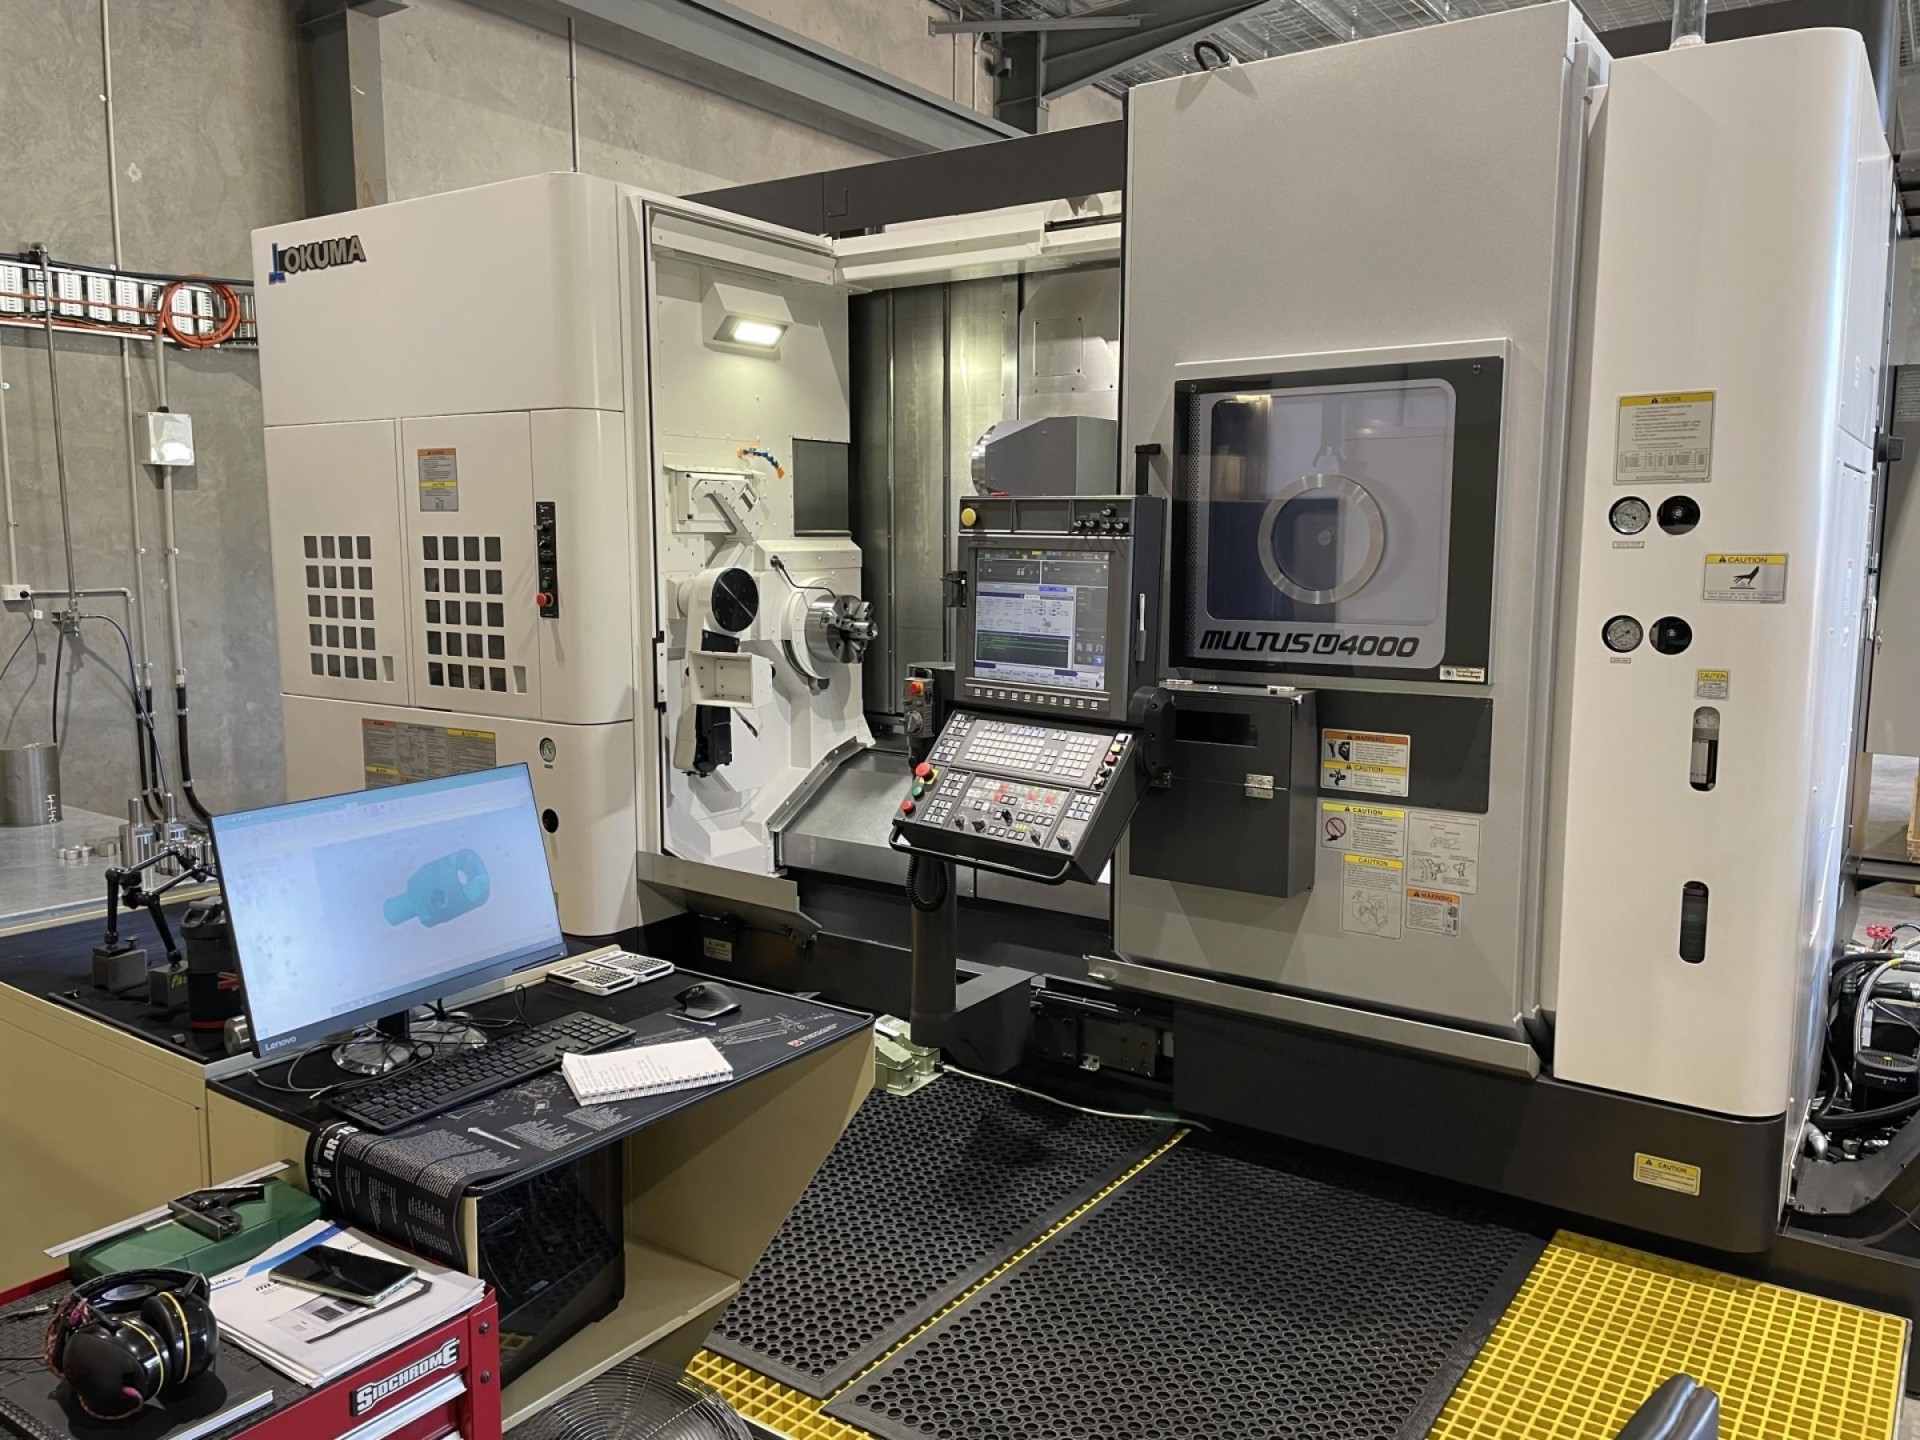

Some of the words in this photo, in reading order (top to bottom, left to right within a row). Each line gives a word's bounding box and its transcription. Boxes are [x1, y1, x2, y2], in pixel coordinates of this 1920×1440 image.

[283, 235, 366, 275] OKUMA
[1727, 556, 1768, 564] CAUTION
[1200, 630, 1313, 653] MULTUS
[1700, 672, 1727, 680] CAUTION
[1355, 735, 1386, 743] WARNING
[1354, 765, 1384, 773] CAUTION
[1353, 807, 1383, 816] CAUTION
[1358, 858, 1388, 867] CAUTION
[265, 1036, 297, 1051] Lenovo
[1658, 1162, 1687, 1174] CAUTION
